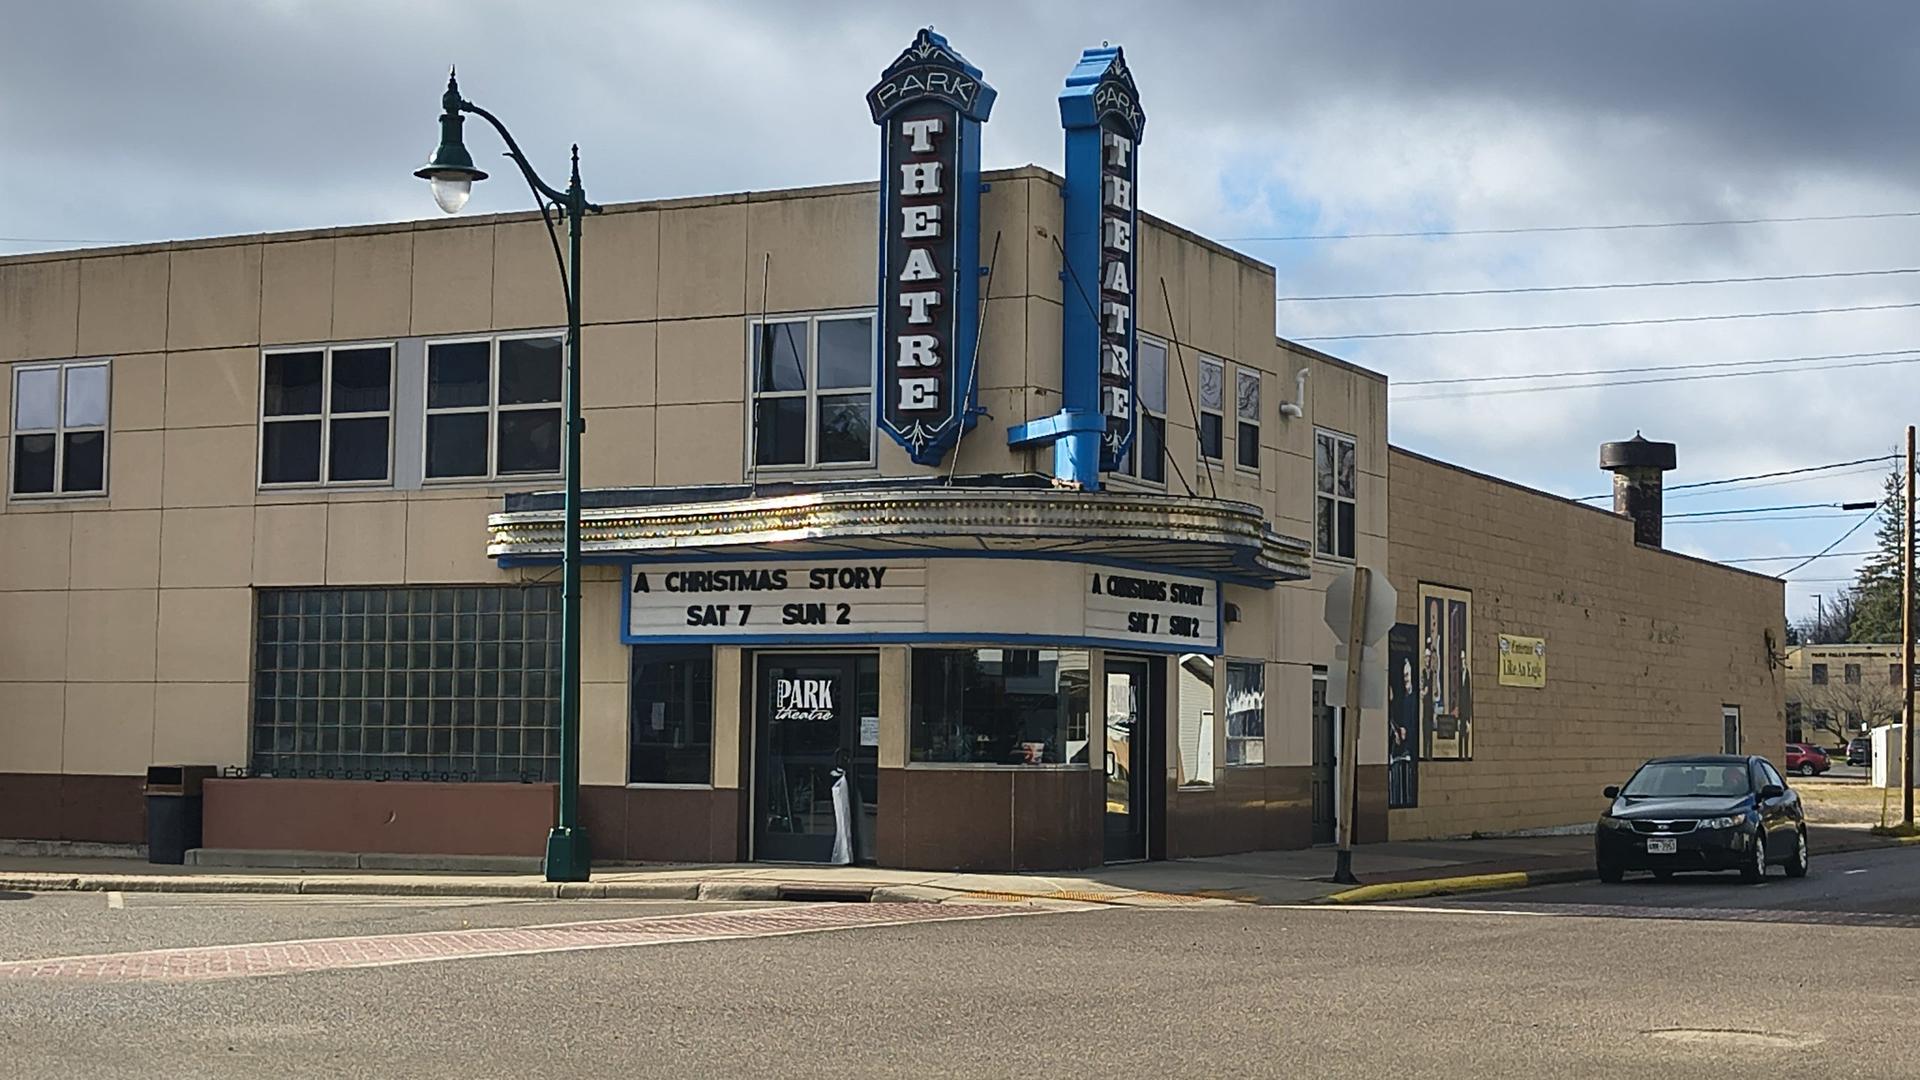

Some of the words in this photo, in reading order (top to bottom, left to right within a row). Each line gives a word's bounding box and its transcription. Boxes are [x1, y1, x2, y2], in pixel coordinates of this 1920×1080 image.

[876, 72, 975, 109] PARK
[1095, 87, 1141, 129] PARK
[897, 119, 944, 410] THEATRE
[1103, 132, 1131, 420] THEATRE
[633, 572, 650, 593] A
[664, 569, 788, 592] CHRISTMAS
[809, 565, 888, 590] STORY
[1092, 573, 1102, 594] A
[1170, 583, 1204, 606] STORY
[686, 604, 730, 626] SAT
[738, 604, 753, 626] 7
[782, 602, 826, 625] SUN
[836, 603, 851, 624] 2
[1192, 617, 1200, 638] 2
[776, 679, 833, 709] PARK
[775, 706, 834, 721] theatre
